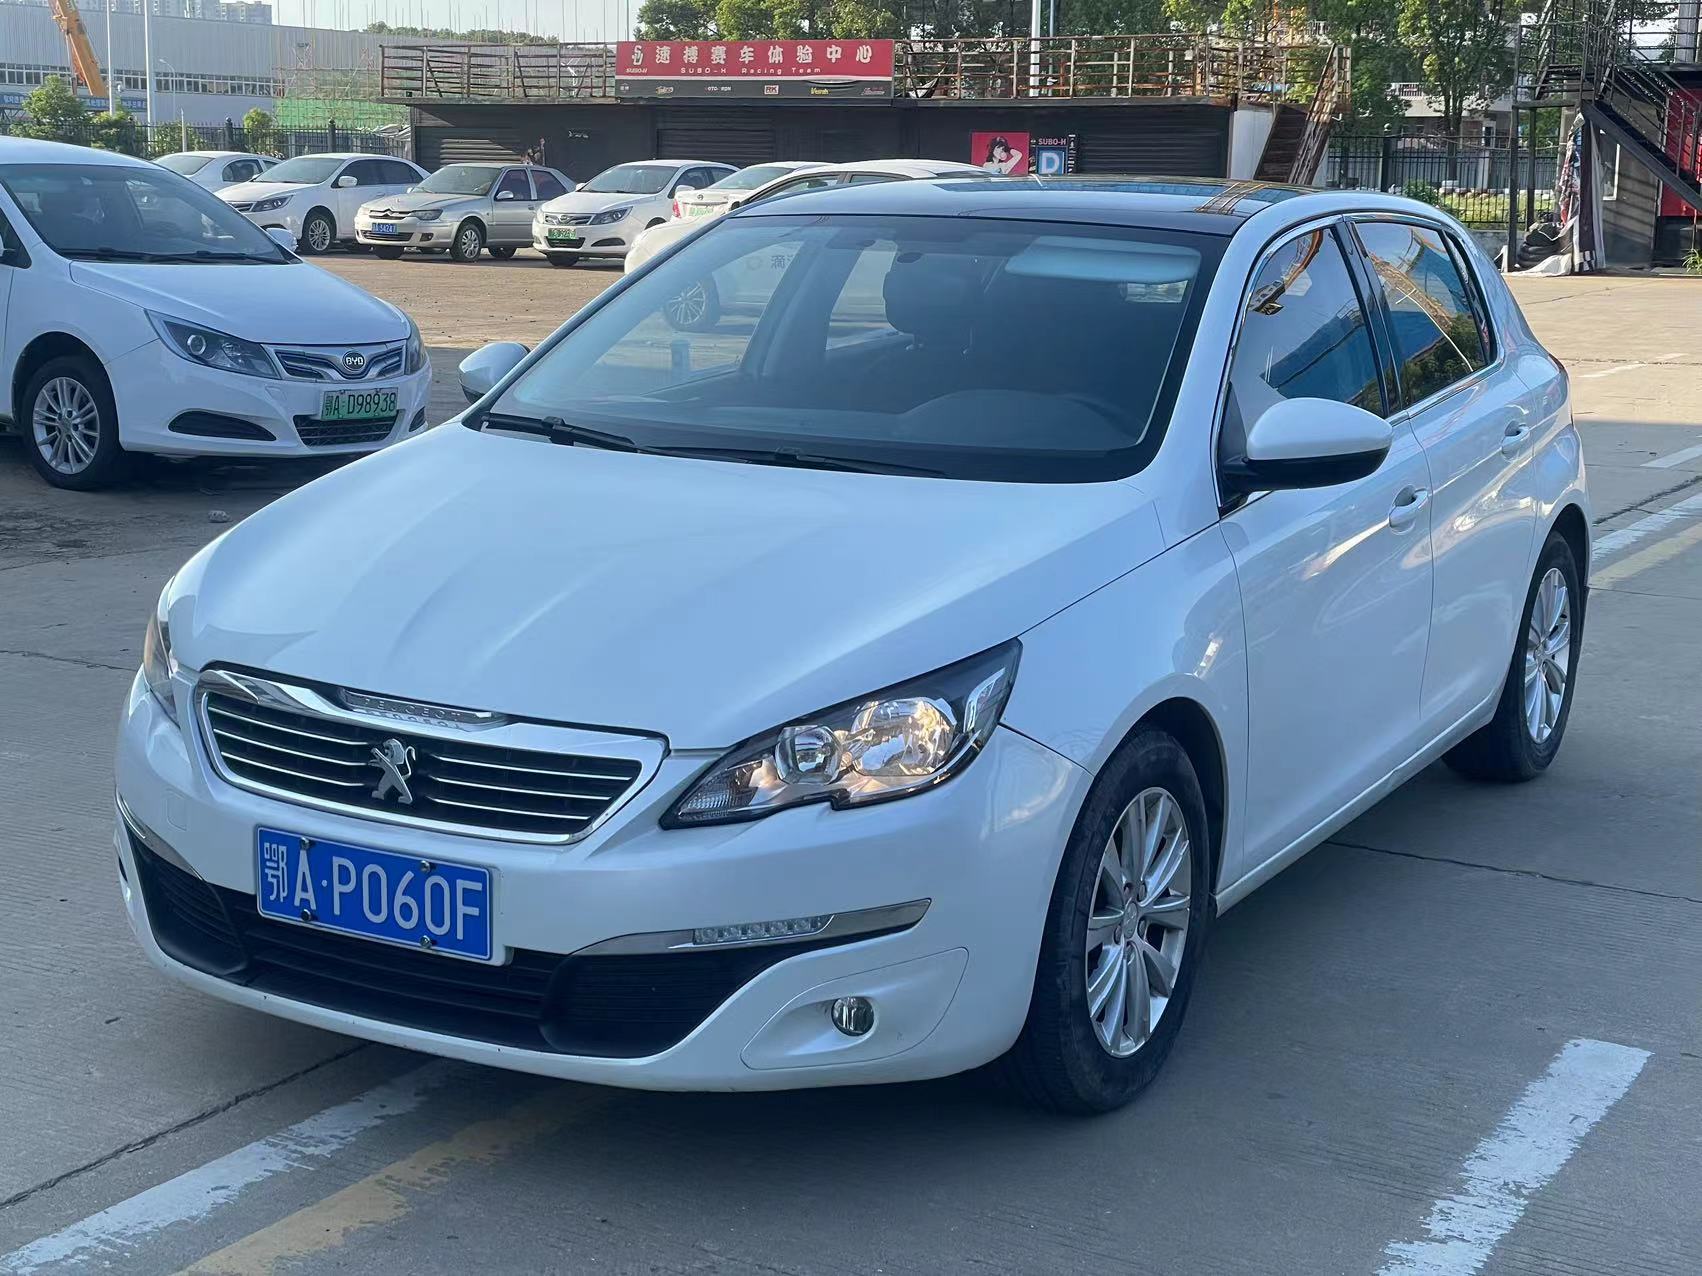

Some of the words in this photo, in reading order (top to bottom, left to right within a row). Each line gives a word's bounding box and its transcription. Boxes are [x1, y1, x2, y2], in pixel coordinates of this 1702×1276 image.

[741, 67, 782, 75] Racing
[345, 356, 364, 365] BYD
[263, 841, 483, 940] 鄂A·P060F
